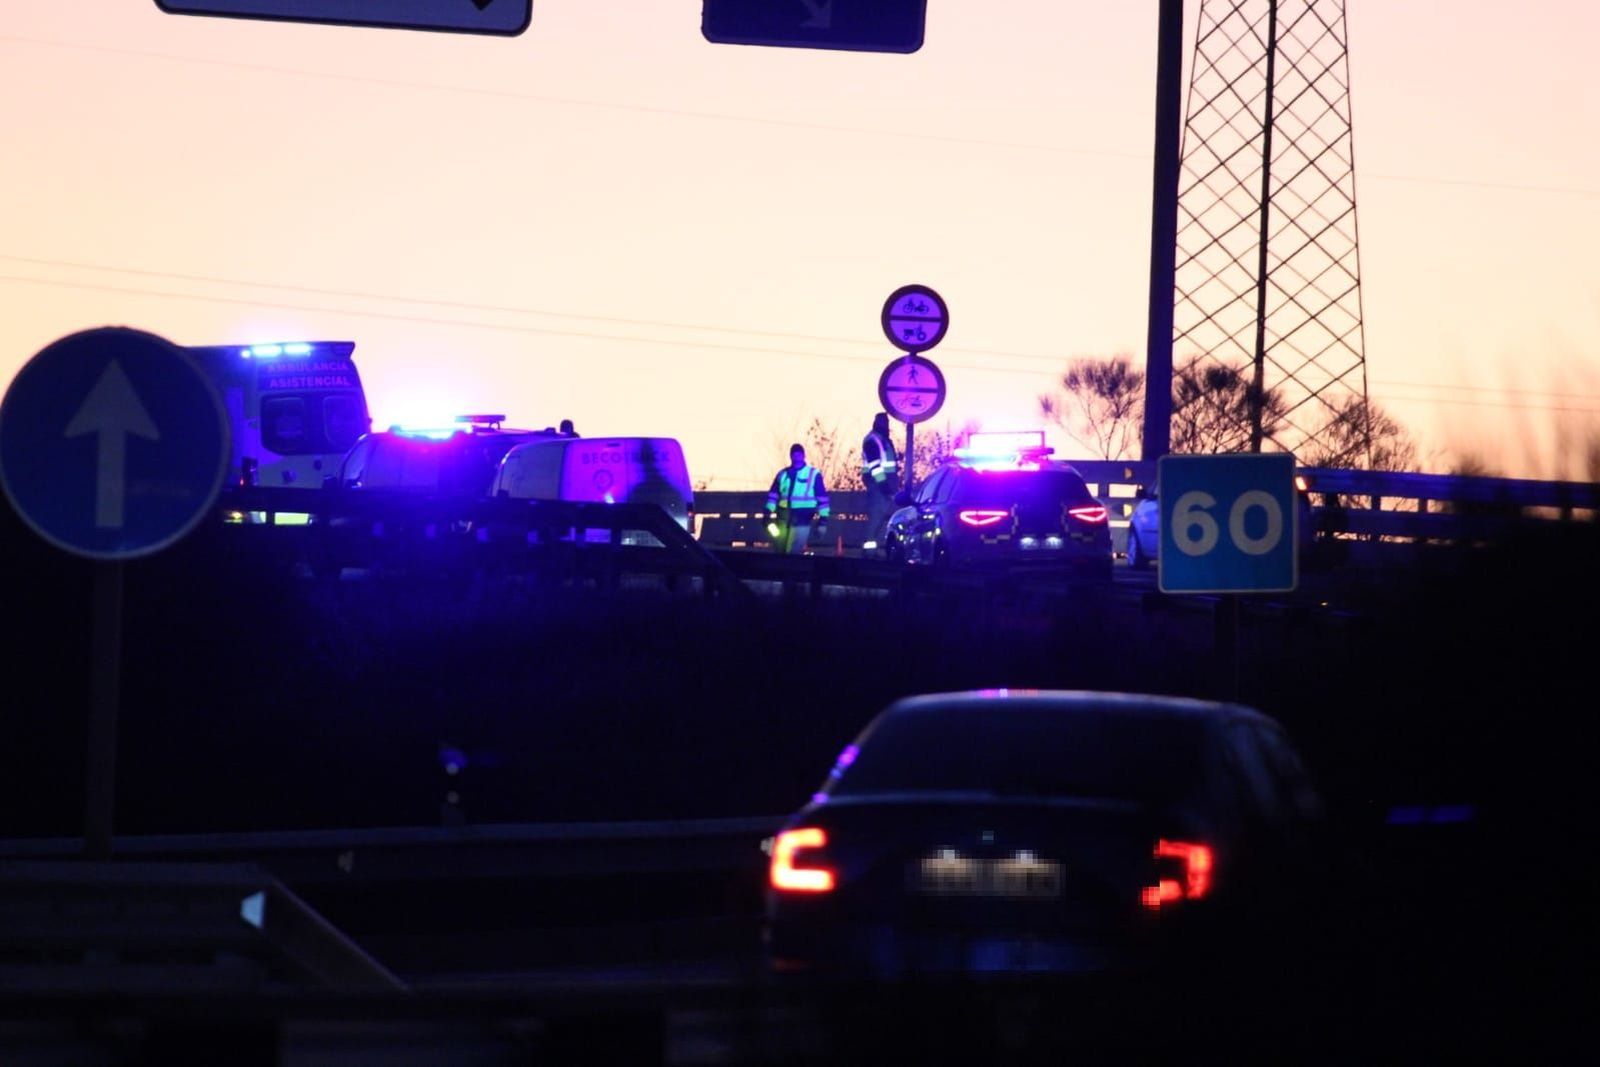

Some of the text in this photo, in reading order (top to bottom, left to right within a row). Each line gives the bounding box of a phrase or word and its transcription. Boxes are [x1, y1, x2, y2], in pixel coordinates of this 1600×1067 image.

[267, 361, 349, 372] AMBULANCIA
[270, 376, 351, 388] ASISTENCIAL
[1171, 490, 1283, 556] 60
